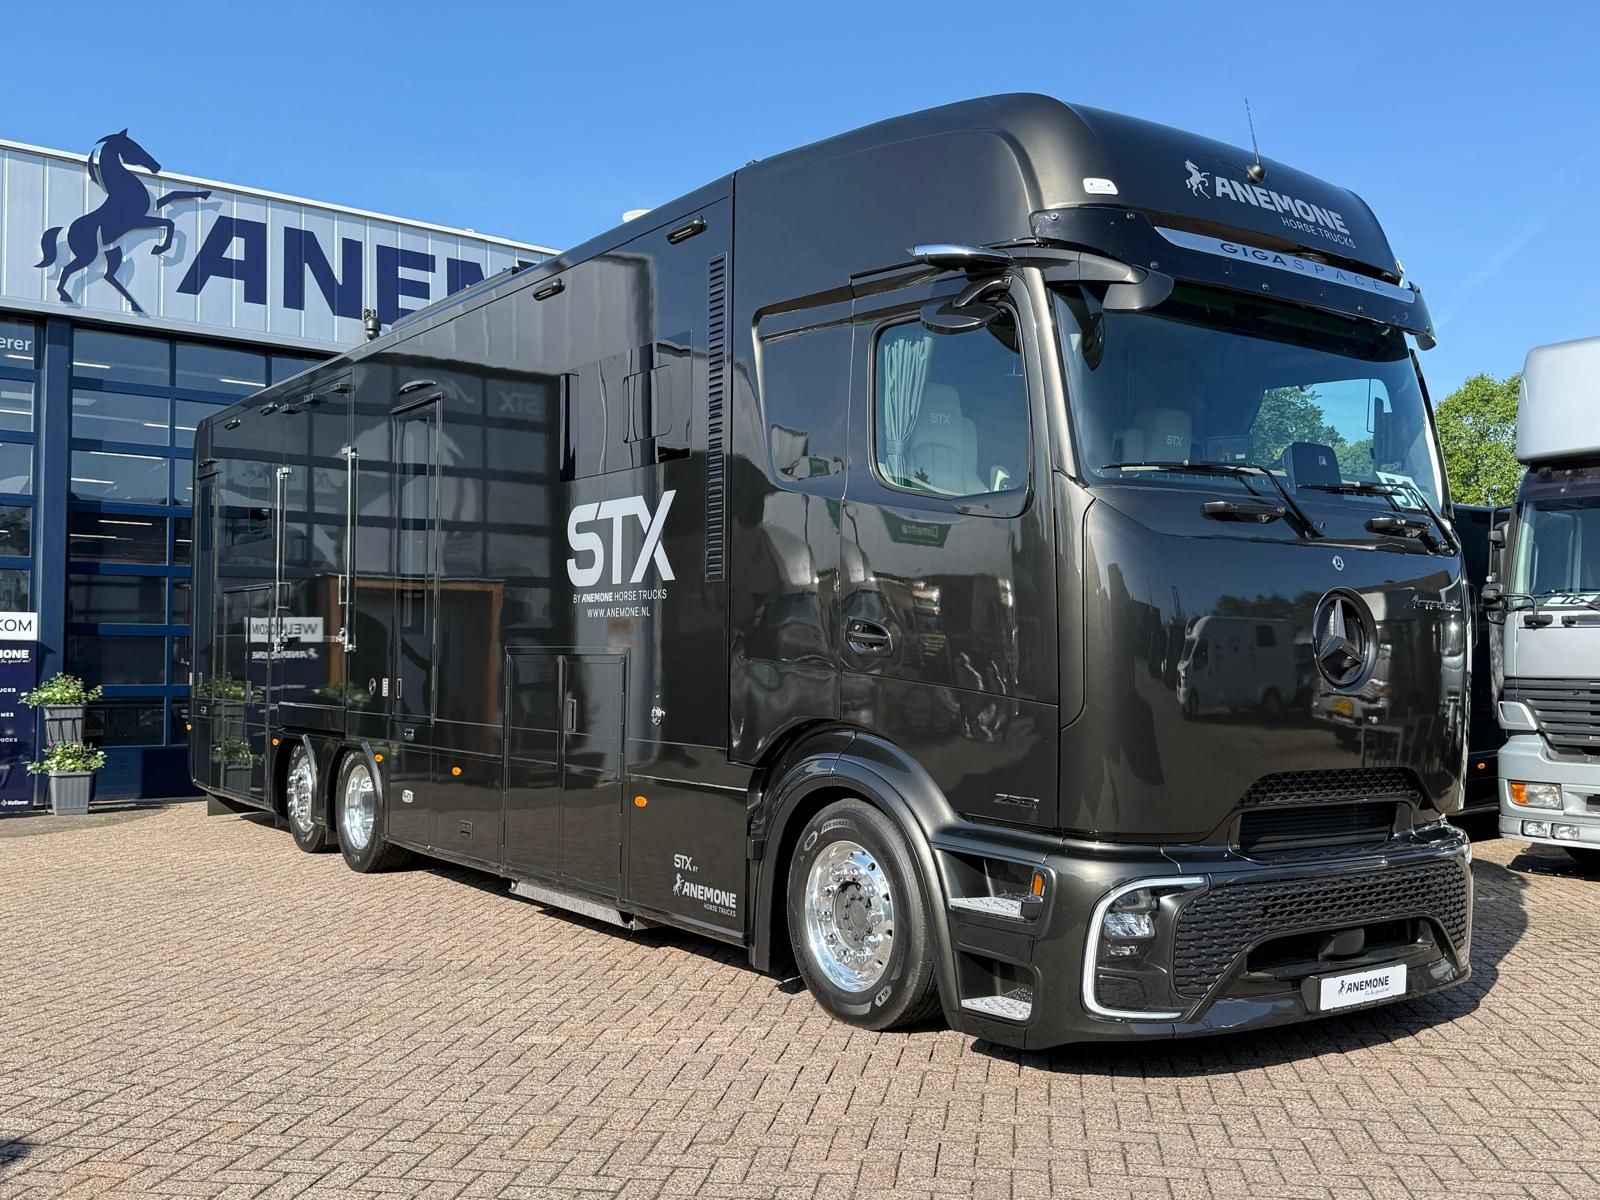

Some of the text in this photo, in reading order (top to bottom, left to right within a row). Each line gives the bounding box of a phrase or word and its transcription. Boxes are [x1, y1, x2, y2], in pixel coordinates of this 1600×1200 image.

[1215, 176, 1350, 235] ANEMONE
[1280, 216, 1356, 249] HORSE TRUCKS
[930, 412, 952, 425] STX
[1166, 434, 1184, 447] STX
[566, 489, 677, 588] STX
[573, 588, 667, 604] BY ANEMONE HORSE TRUCKS
[586, 606, 651, 618] WWW.ANEMONE.NL
[674, 854, 692, 871] STX
[682, 882, 736, 908] ANEMONE
[704, 903, 736, 917] HORSE TRUCKS
[1346, 976, 1389, 993] ANEMONE
